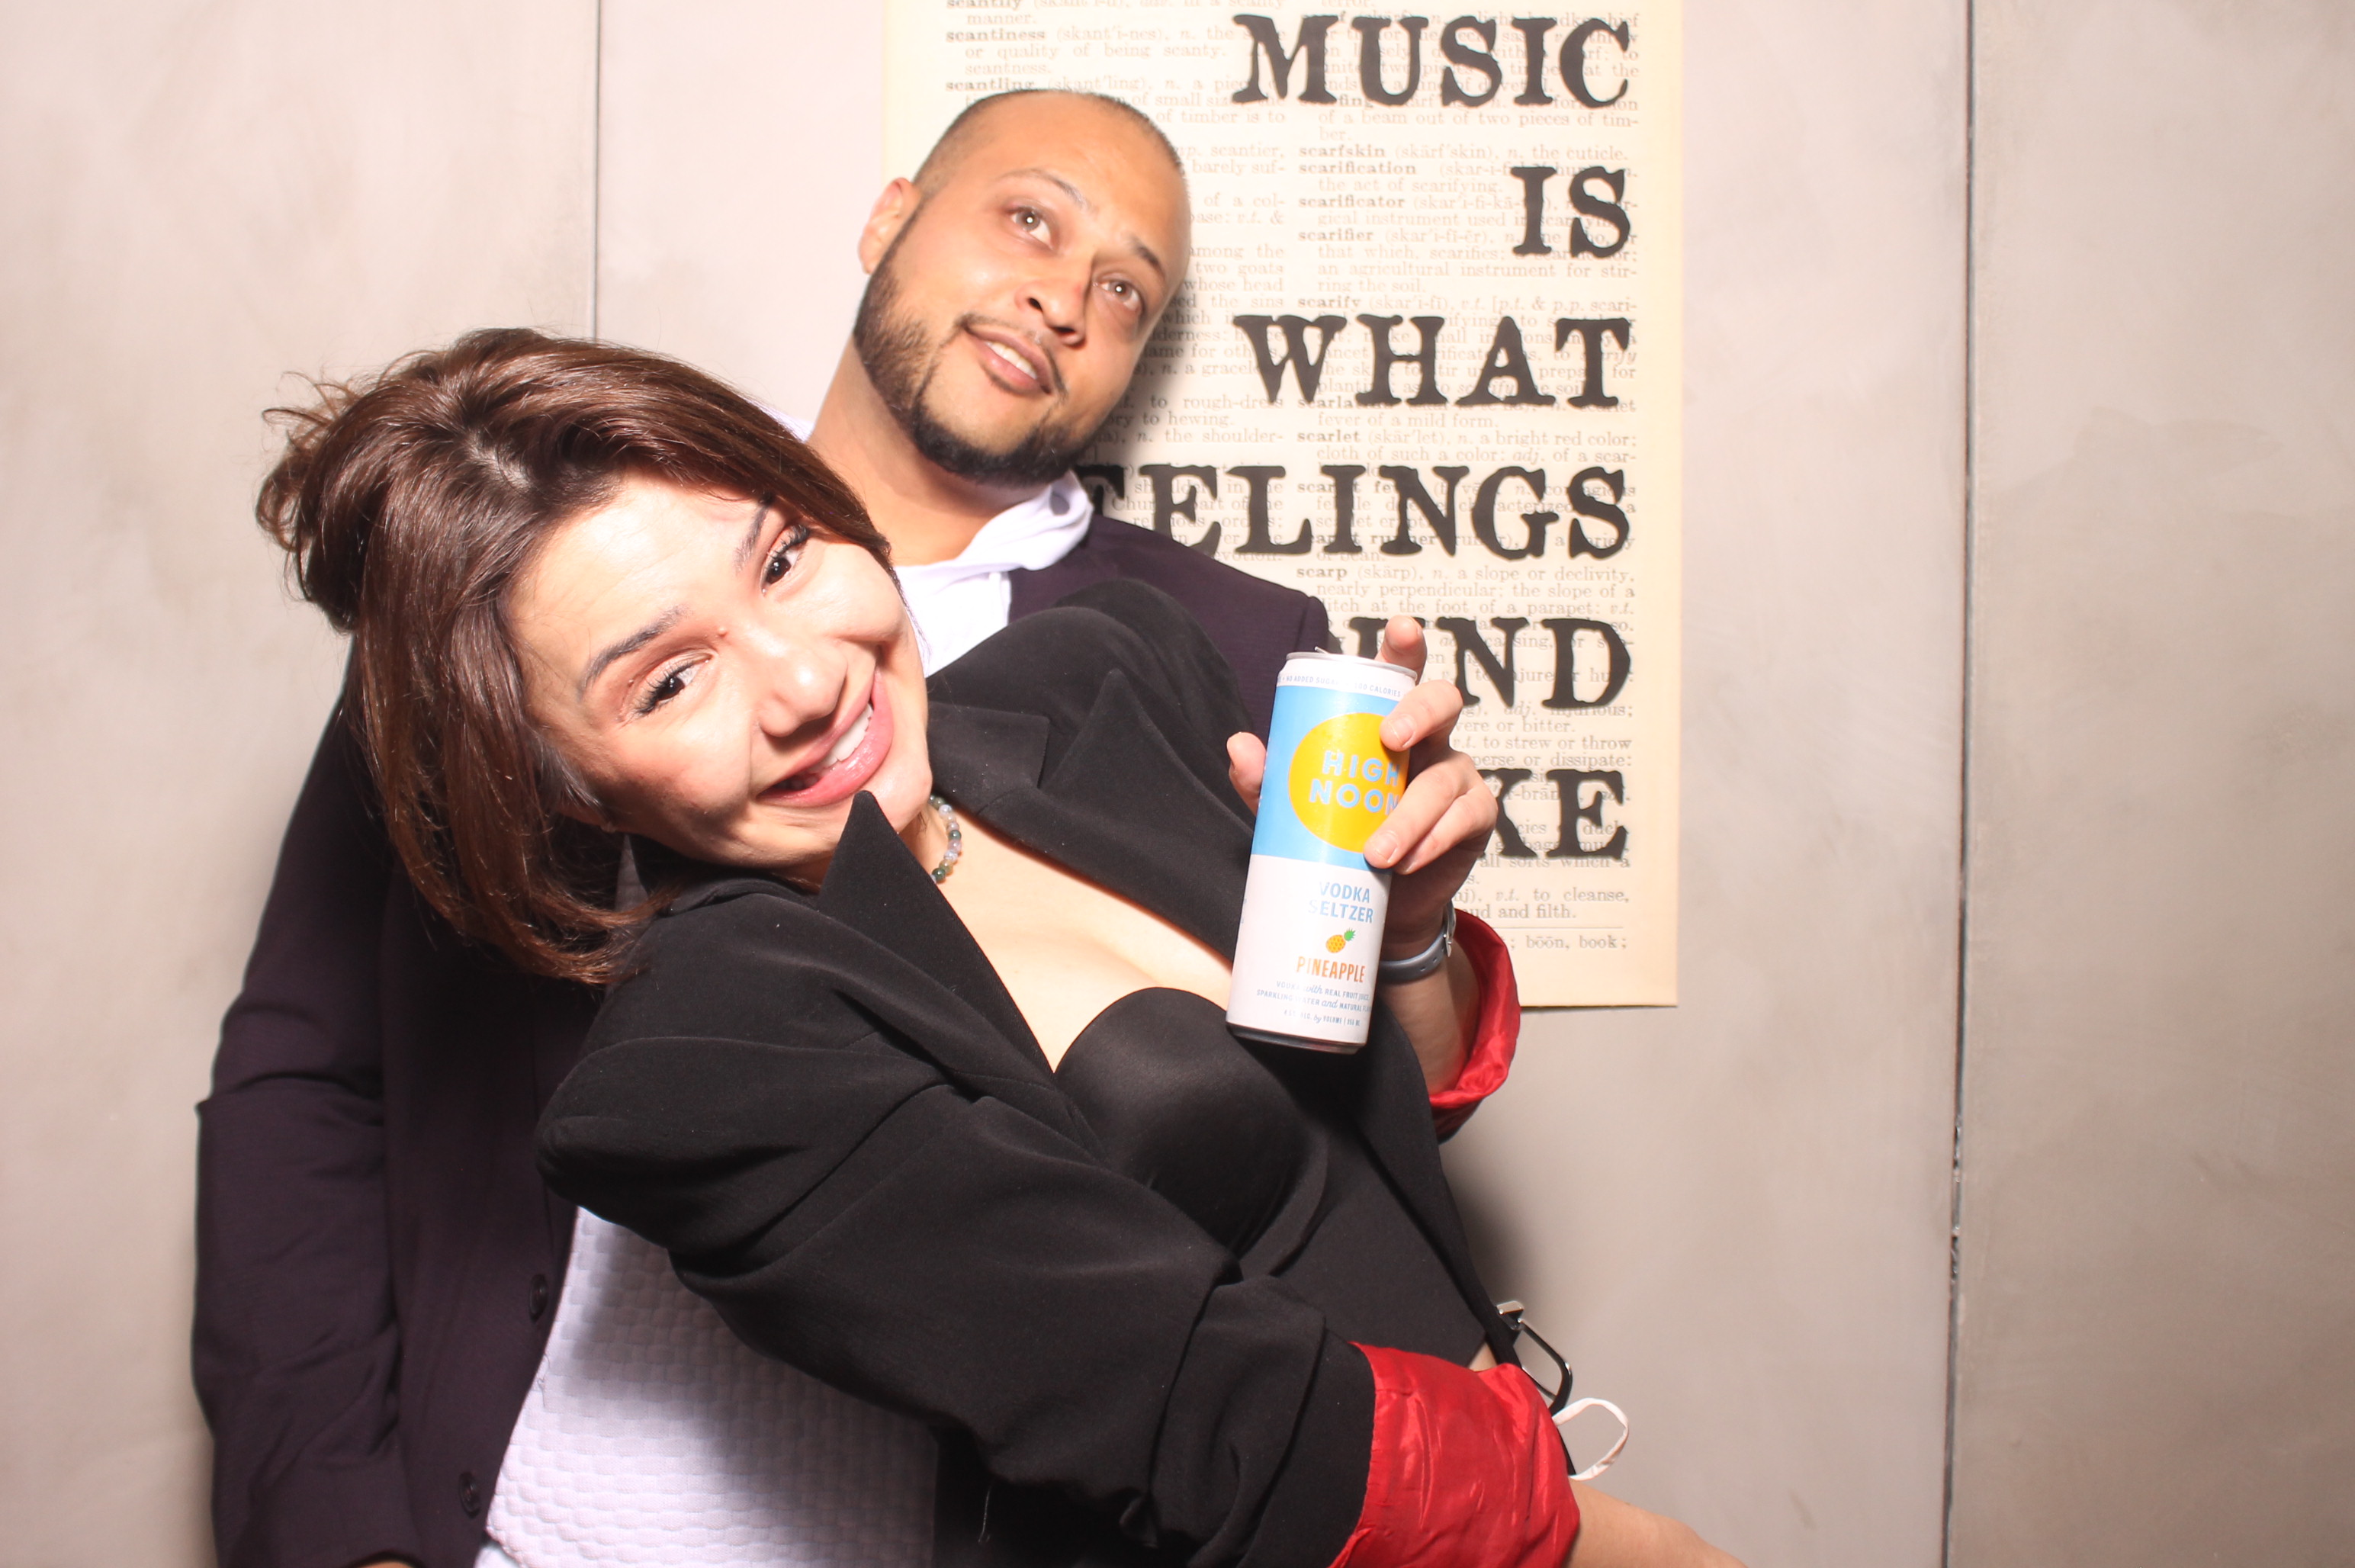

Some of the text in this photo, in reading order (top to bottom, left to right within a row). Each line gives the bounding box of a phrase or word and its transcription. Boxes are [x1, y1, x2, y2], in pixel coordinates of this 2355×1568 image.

[967, 14, 1036, 24] manner.
[946, 25, 1234, 43] scantiness the
[965, 43, 1226, 61] or quality of being scanty.
[965, 63, 1051, 75] scantness.
[1232, 14, 1630, 108] MUSIC
[1155, 92, 1201, 107] small
[1156, 108, 1285, 124] of timber is to
[1319, 111, 1639, 128] of beam out of two pieces of tim-
[1319, 127, 1351, 140] ber.
[1211, 145, 1284, 159] scantier,
[1299, 143, 1628, 160] scarfskin the cuticle.
[1193, 159, 1285, 176] barely suf-
[1299, 161, 1417, 175] scarification
[1318, 177, 1502, 196] the act of scarifying.
[1204, 192, 1284, 207] of col-
[1298, 194, 1406, 208] scarificator
[1318, 210, 1505, 226] gical instrument used
[1511, 165, 1631, 259] IS
[1298, 227, 1374, 242] scarifier
[1257, 243, 1284, 258] the
[1318, 244, 1353, 258] that
[1364, 244, 1418, 259] which,
[1195, 262, 1284, 278] two goats
[1318, 261, 1637, 278] an agricultural instrument for stir-
[1184, 275, 1283, 291] whose head
[1318, 278, 1425, 292] ring the soil.
[1211, 294, 1284, 308] the sins
[1298, 295, 1362, 313] scarify
[1591, 297, 1637, 312] scari-
[1192, 342, 1216, 358] for
[1233, 313, 1632, 408] WHAT
[1168, 413, 1235, 428] hewing.
[1319, 412, 1499, 427] fever of mild form.
[1165, 428, 1283, 442] the shoulder-
[1296, 429, 1361, 443] scarlet
[1496, 429, 1548, 447] bright
[1554, 430, 1582, 445] red
[1317, 445, 1360, 460] cloth
[1367, 447, 1383, 461] of
[1391, 446, 1430, 461] such
[1553, 448, 1569, 462] of
[1595, 452, 1637, 463] scar-
[1296, 568, 1348, 582] scarp
[1476, 565, 1520, 583] slope
[1528, 570, 1546, 580] or
[1316, 581, 1371, 600] nearly
[1512, 582, 1541, 596] the
[1548, 583, 1592, 600] slope
[1599, 583, 1616, 598] of
[1370, 600, 1388, 612] at
[1399, 598, 1425, 613] the
[1435, 599, 1469, 616] foot
[1480, 599, 1496, 614] of
[1370, 685, 1401, 697] CALORIES
[1496, 717, 1573, 732] or bitter.
[1483, 734, 1632, 750] to strew or throw
[1322, 750, 1400, 787] HIGH
[1523, 756, 1541, 766] or
[1319, 881, 1371, 904] VODKA
[1532, 888, 1550, 901] to
[1563, 886, 1629, 903] cleanse,
[1308, 899, 1374, 924] SELTZER
[1498, 903, 1576, 918] and filth.
[1296, 956, 1366, 984] PINEAPPLE
